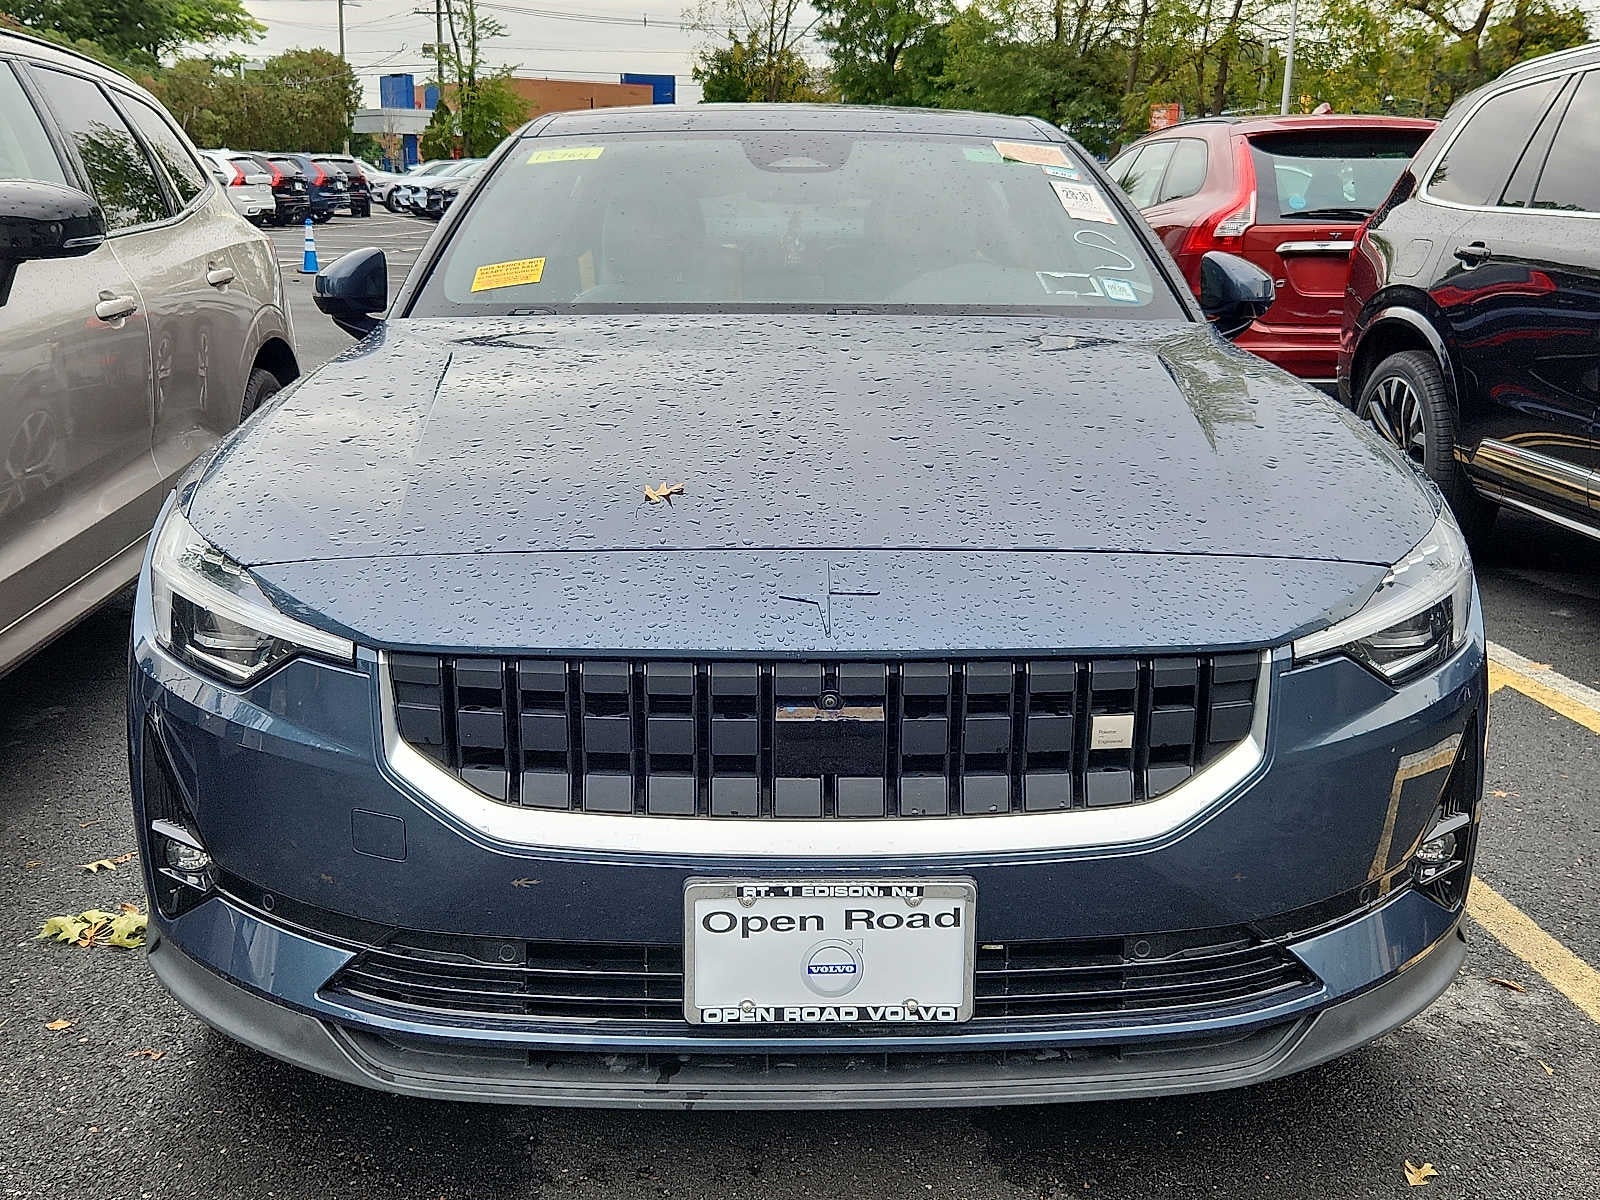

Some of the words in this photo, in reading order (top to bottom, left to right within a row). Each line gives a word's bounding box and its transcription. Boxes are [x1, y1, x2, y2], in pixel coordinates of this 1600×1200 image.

[743, 886, 775, 897] RT.
[784, 886, 793, 897] 1
[891, 886, 918, 897] NJ
[702, 911, 824, 939] Open
[844, 907, 961, 931] Road
[809, 964, 855, 974] VOLVO
[702, 1007, 775, 1023] OPEN
[783, 1006, 859, 1022] ROAD
[866, 1005, 956, 1022] VOLVO
